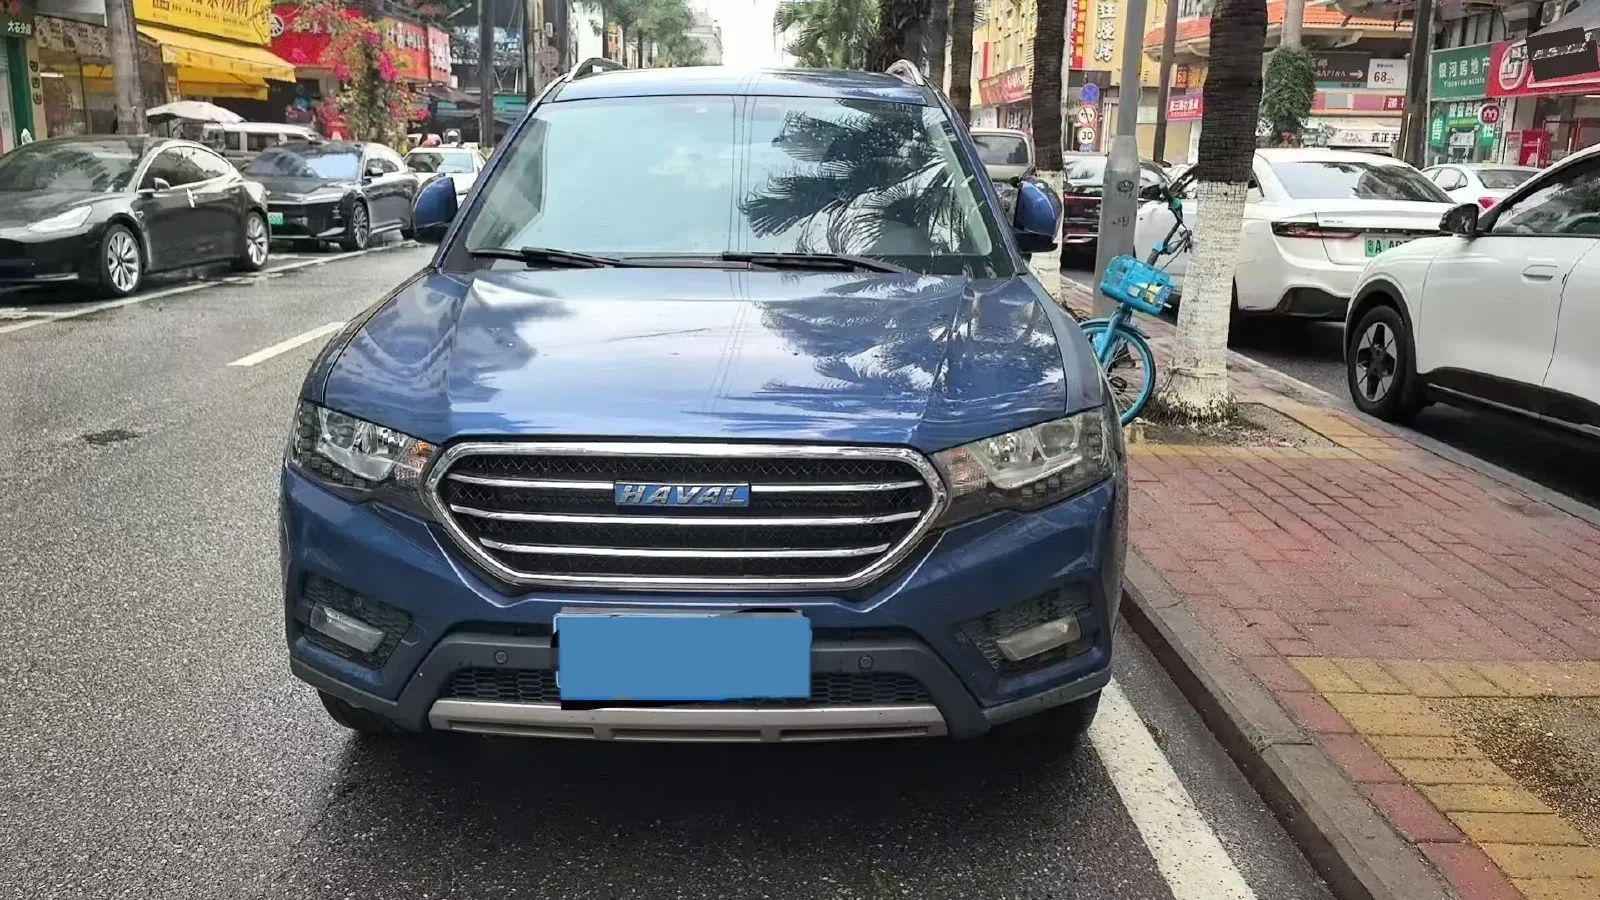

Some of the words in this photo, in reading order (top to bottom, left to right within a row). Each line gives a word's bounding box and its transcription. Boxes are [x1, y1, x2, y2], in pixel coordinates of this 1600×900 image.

[1438, 57, 1491, 79] 银河房地产
[1374, 71, 1387, 82] 68
[1082, 131, 1093, 140] 30
[619, 485, 745, 503] HAVAL
